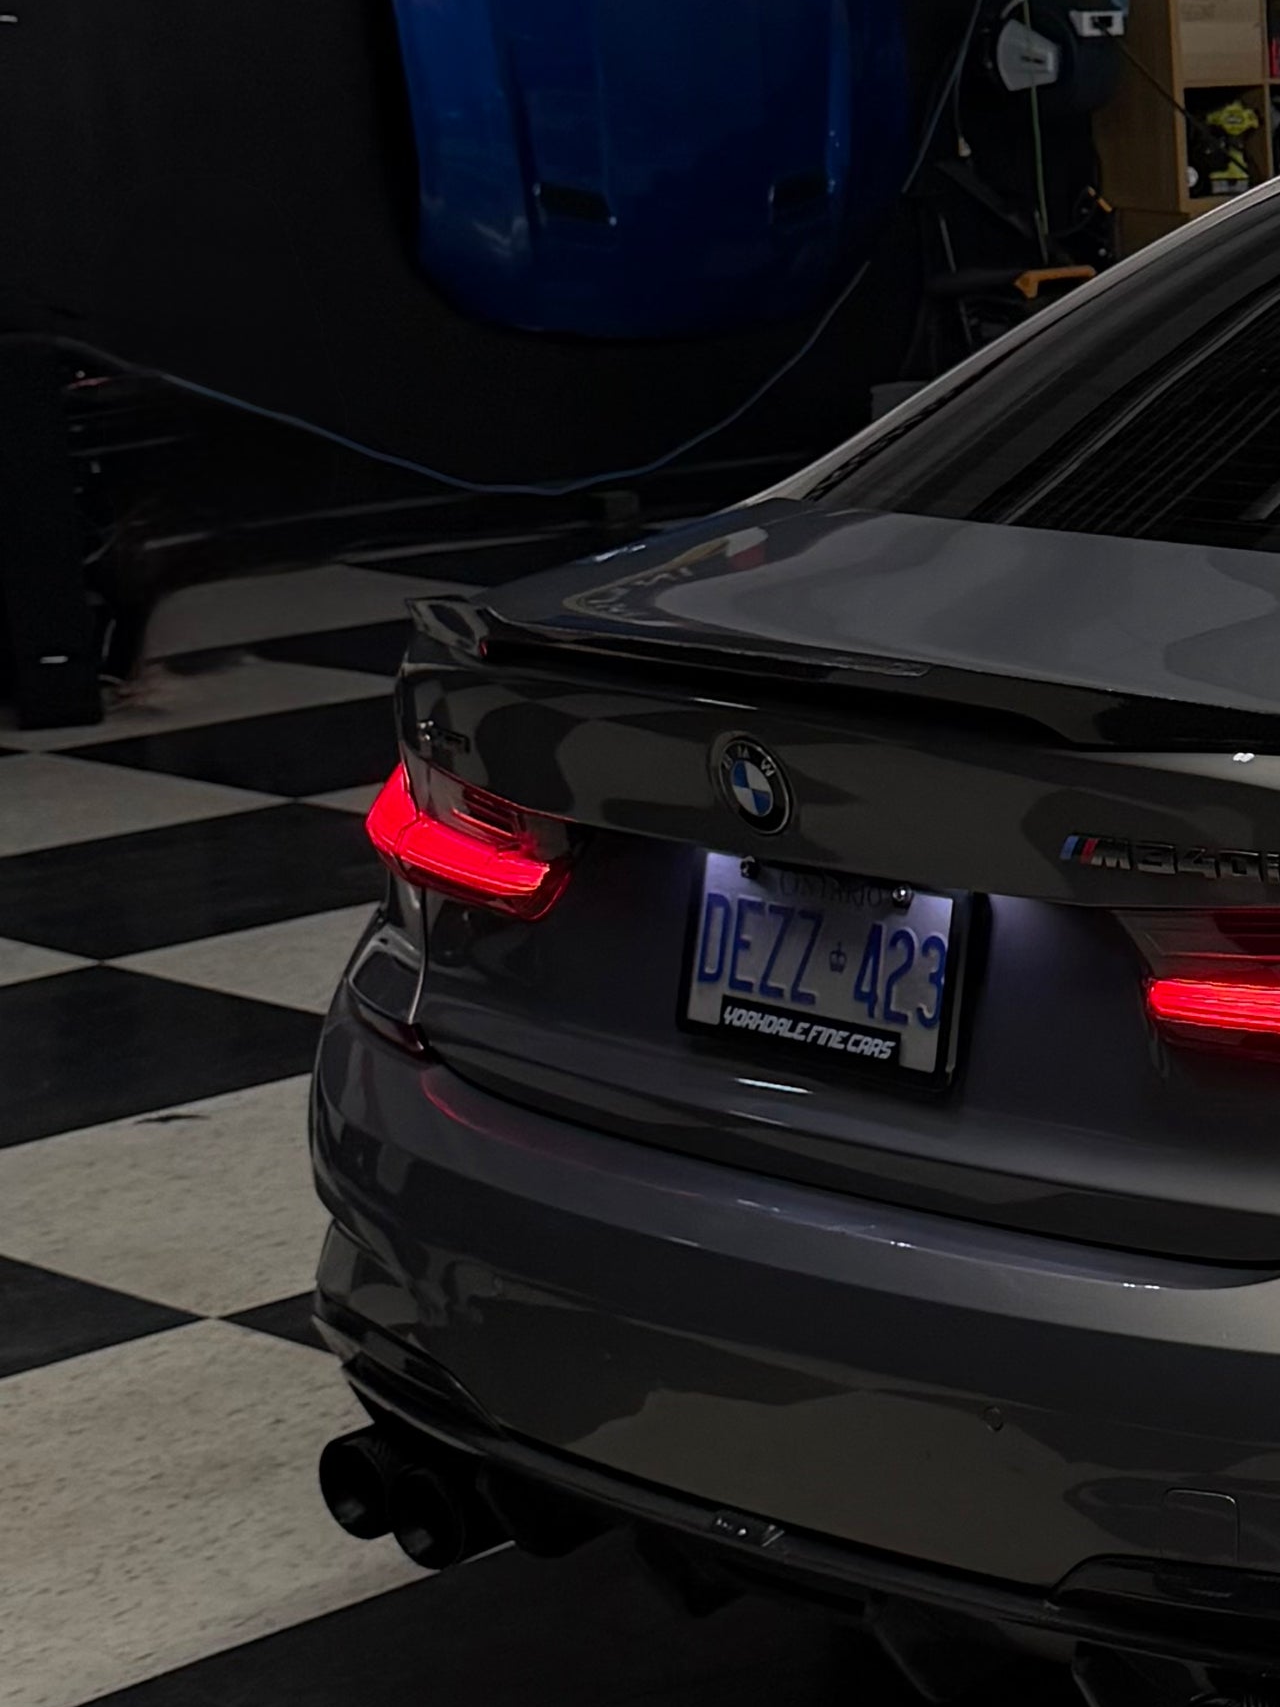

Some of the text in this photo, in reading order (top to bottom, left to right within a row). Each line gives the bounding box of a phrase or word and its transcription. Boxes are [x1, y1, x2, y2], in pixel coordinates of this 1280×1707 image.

[697, 892, 948, 1030] DEZZ 423
[722, 1004, 897, 1060] YORKDALE FINE CARS
